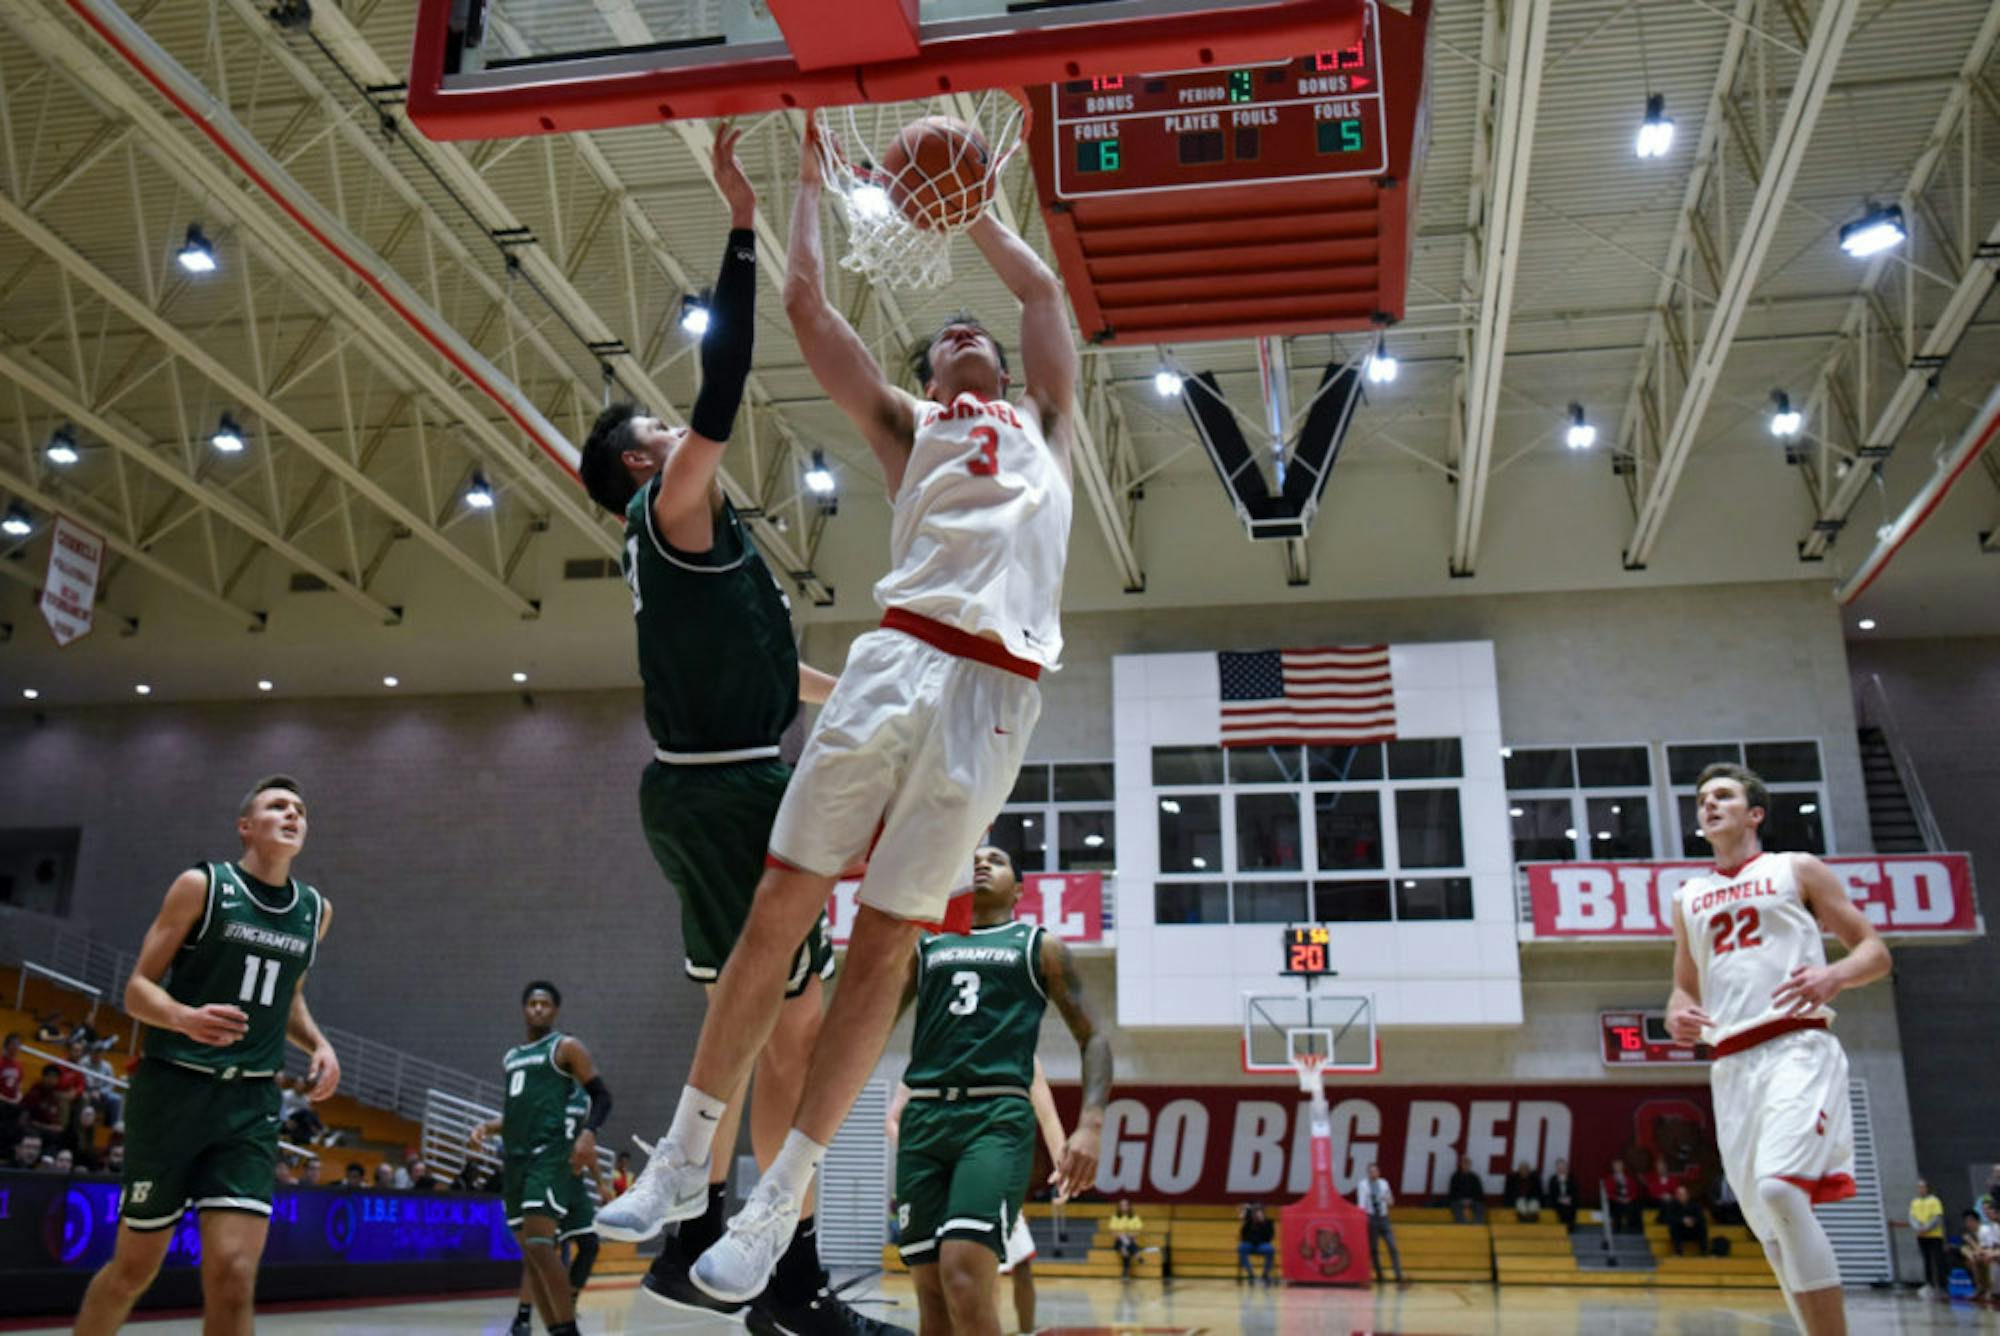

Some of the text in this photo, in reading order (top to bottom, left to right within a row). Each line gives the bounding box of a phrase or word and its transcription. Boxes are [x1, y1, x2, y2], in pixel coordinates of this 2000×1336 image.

[1179, 86, 1225, 103] PERIOD
[1298, 75, 1347, 95] BONUS
[1086, 94, 1134, 113] BONUS
[1314, 101, 1361, 120] FOULS
[1074, 121, 1120, 141] FOULS
[1165, 107, 1278, 133] PLAYER FOULS
[1341, 120, 1361, 151] 5
[1100, 140, 1120, 171] 6
[967, 425, 999, 477] 3
[1691, 878, 1777, 914] CORNELL
[224, 923, 308, 954] BINGHAMTON
[1709, 906, 1762, 955] 22
[1291, 945, 1325, 972] 20
[239, 953, 281, 1006] 11
[949, 970, 981, 1015] 3
[1611, 1026, 1641, 1050] 76
[510, 1070, 526, 1097] 0
[1096, 1099, 1572, 1196] GO BIG RED
